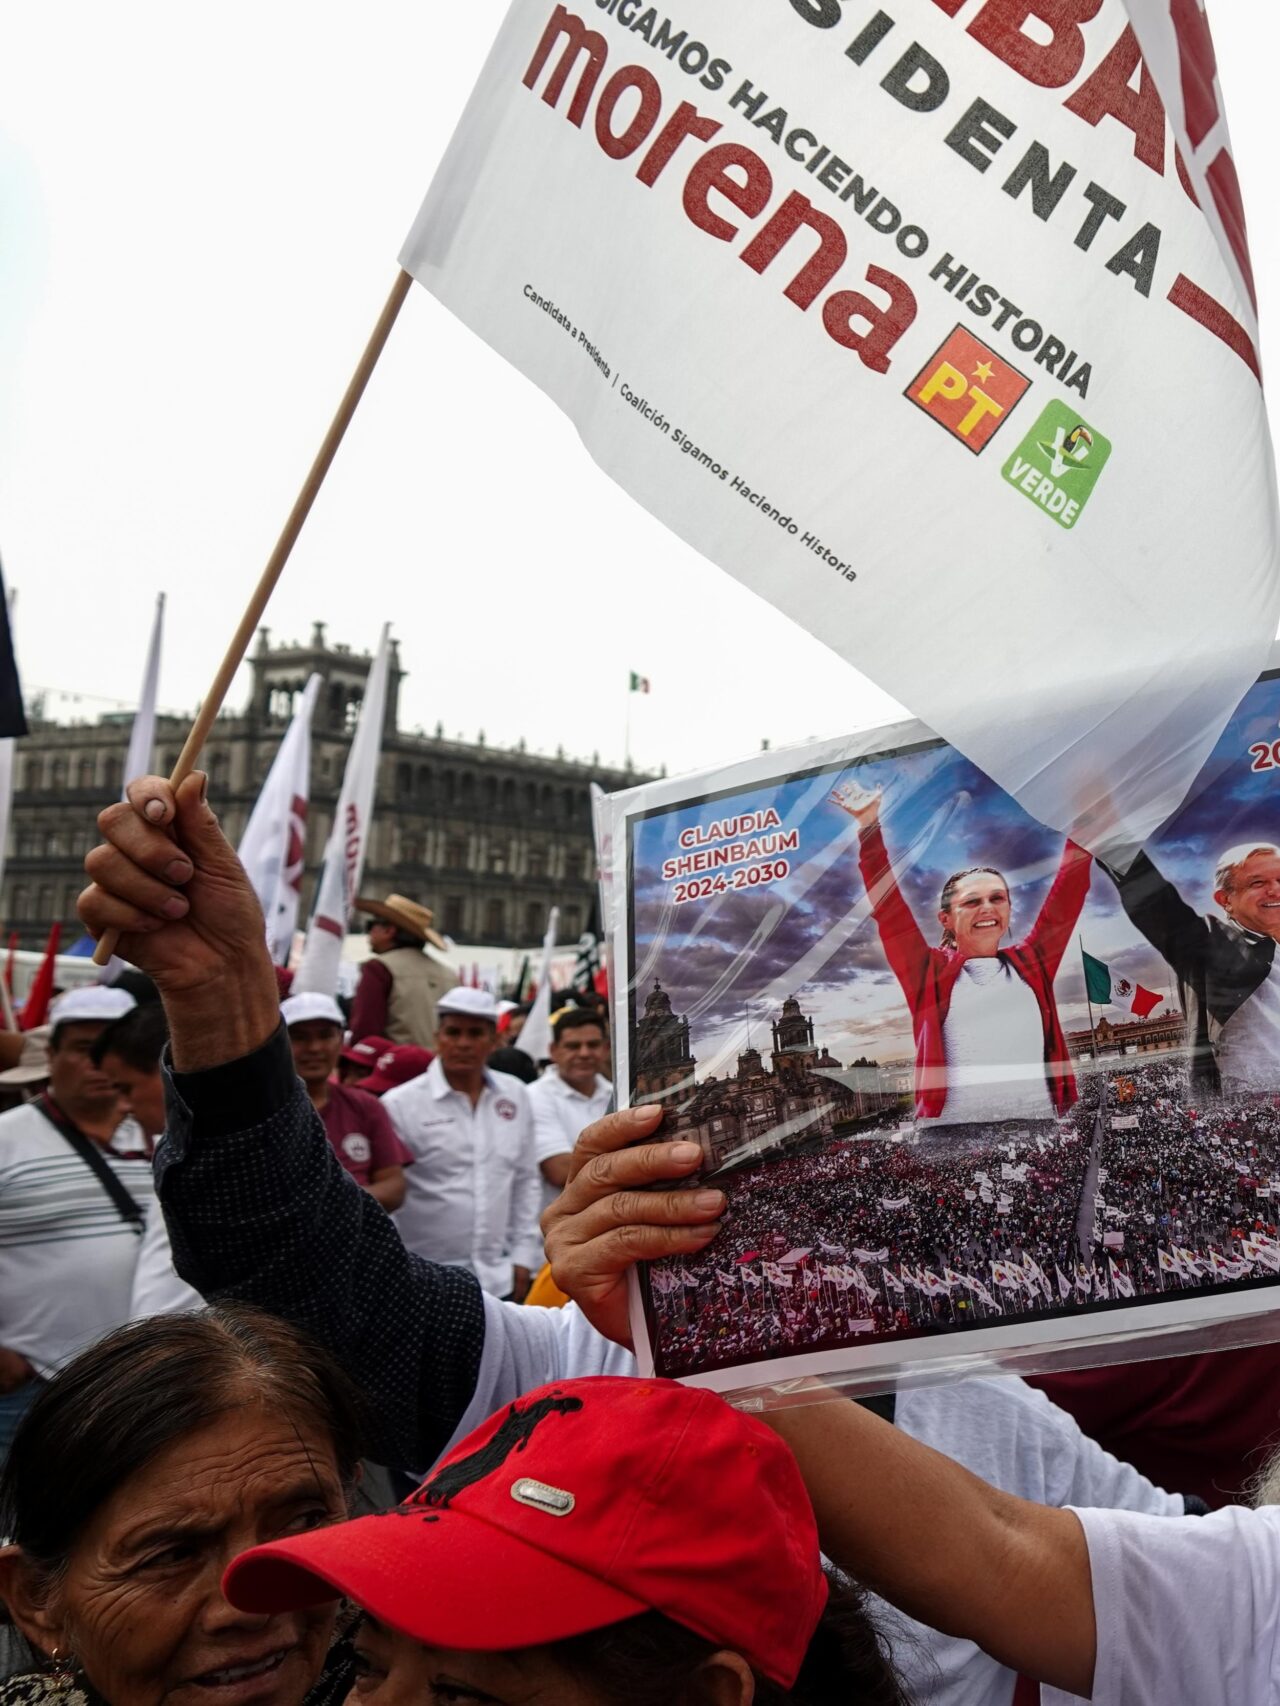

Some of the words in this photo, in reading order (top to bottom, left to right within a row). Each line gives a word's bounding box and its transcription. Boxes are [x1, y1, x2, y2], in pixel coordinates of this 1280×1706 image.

[522, 3, 918, 375] morena
[918, 360, 1004, 437] PT
[595, 0, 732, 91] GAMOS
[728, 79, 929, 259] HACIENDO
[928, 252, 1092, 400] HISTORIA
[523, 283, 572, 332] Candidata
[571, 327, 578, 339] a
[577, 331, 611, 379] Presidenta
[620, 382, 671, 434] Coalición
[671, 428, 729, 481] Sigamos
[729, 475, 799, 535] Haciendo
[799, 531, 858, 583] Historia
[1009, 456, 1080, 525] VERDE
[663, 830, 799, 880] SHEINBAUM
[679, 809, 781, 848] CLAUDIA
[674, 860, 789, 904] 2024-2030
